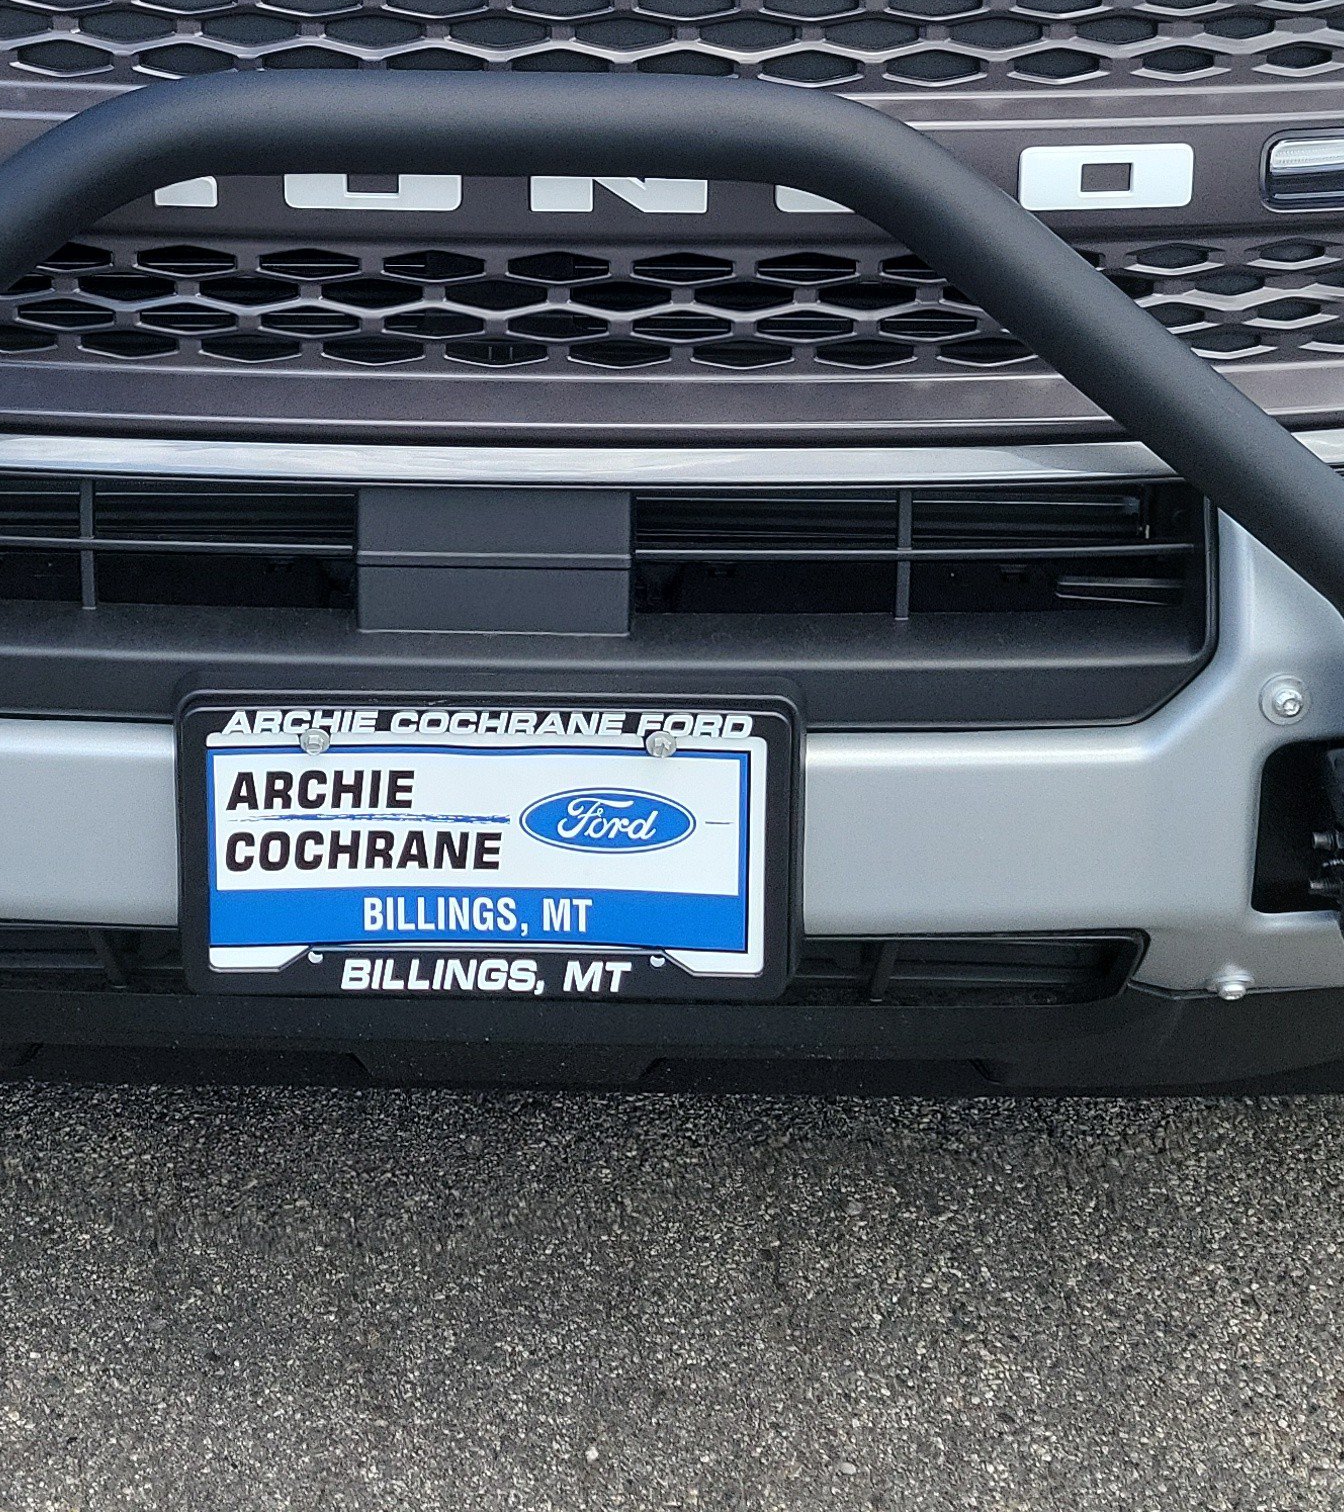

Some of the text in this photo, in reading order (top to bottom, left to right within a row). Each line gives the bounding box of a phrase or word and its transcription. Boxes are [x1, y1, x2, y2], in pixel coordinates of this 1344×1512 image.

[221, 709, 754, 738] ARCHIE COCHRANE FORD
[225, 769, 416, 811] ARCHIE
[556, 796, 659, 840] Ford
[224, 829, 503, 873] COCHRANE
[363, 896, 594, 937] BILLINGS, MT
[340, 958, 633, 996] BILLINGS, MT
